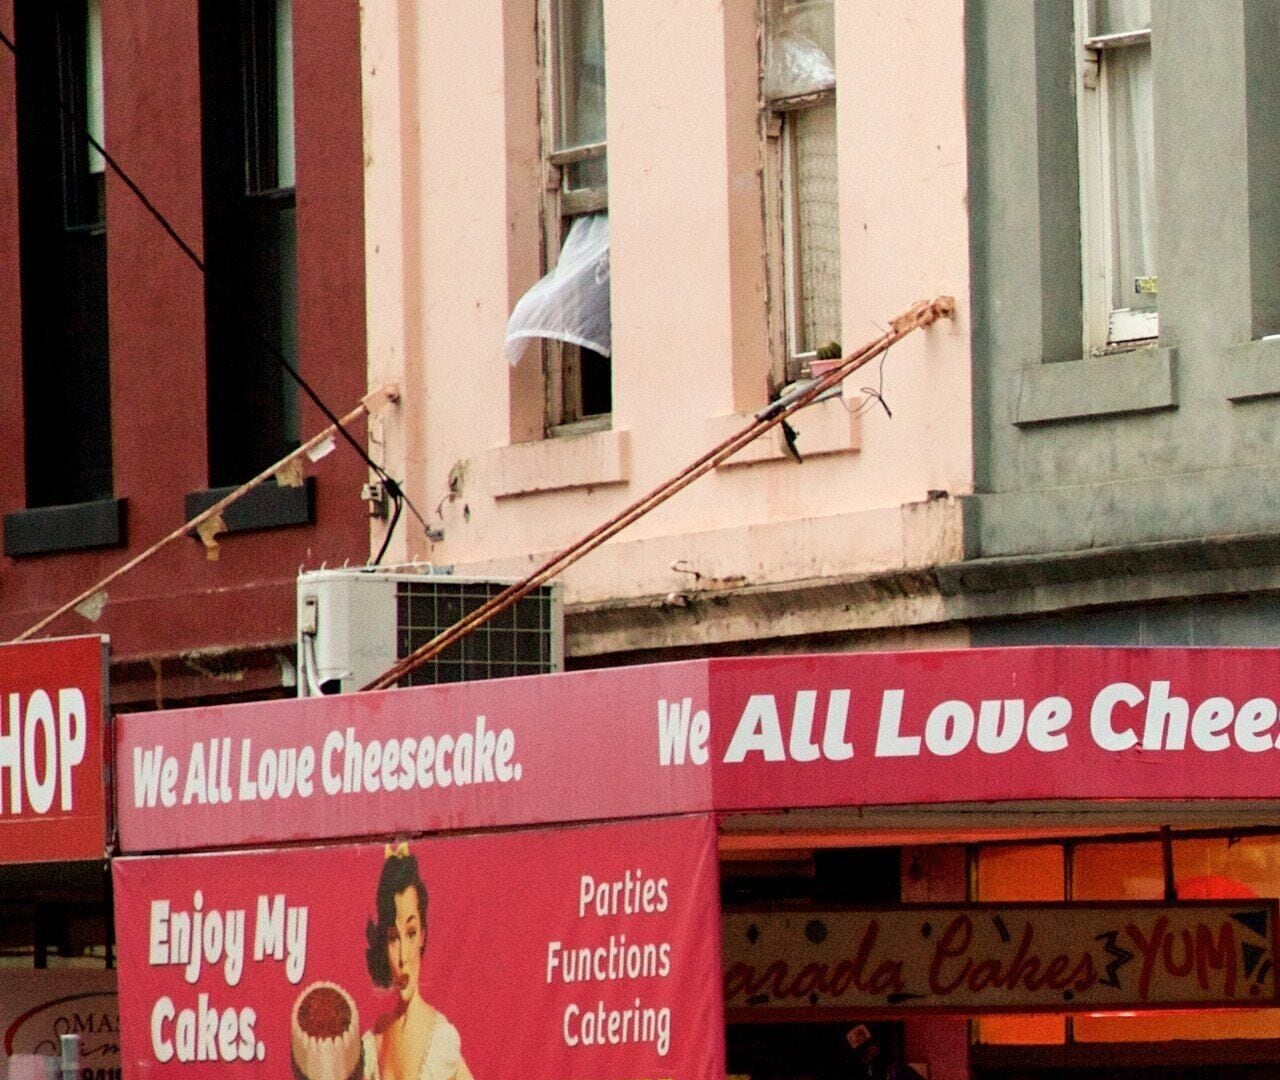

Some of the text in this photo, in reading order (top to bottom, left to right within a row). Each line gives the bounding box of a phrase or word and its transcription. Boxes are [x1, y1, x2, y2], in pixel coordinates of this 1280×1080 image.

[133, 715, 522, 808] We All Love Cheesecake.
[658, 697, 710, 766] We
[723, 690, 854, 763] All
[875, 690, 1072, 758] Love
[579, 869, 669, 918] Parties
[149, 889, 308, 987] Enjoy My
[547, 935, 672, 983] Functions
[929, 915, 1098, 992] Cakes
[151, 993, 266, 1063] Cakes.
[563, 998, 671, 1056] Catering
